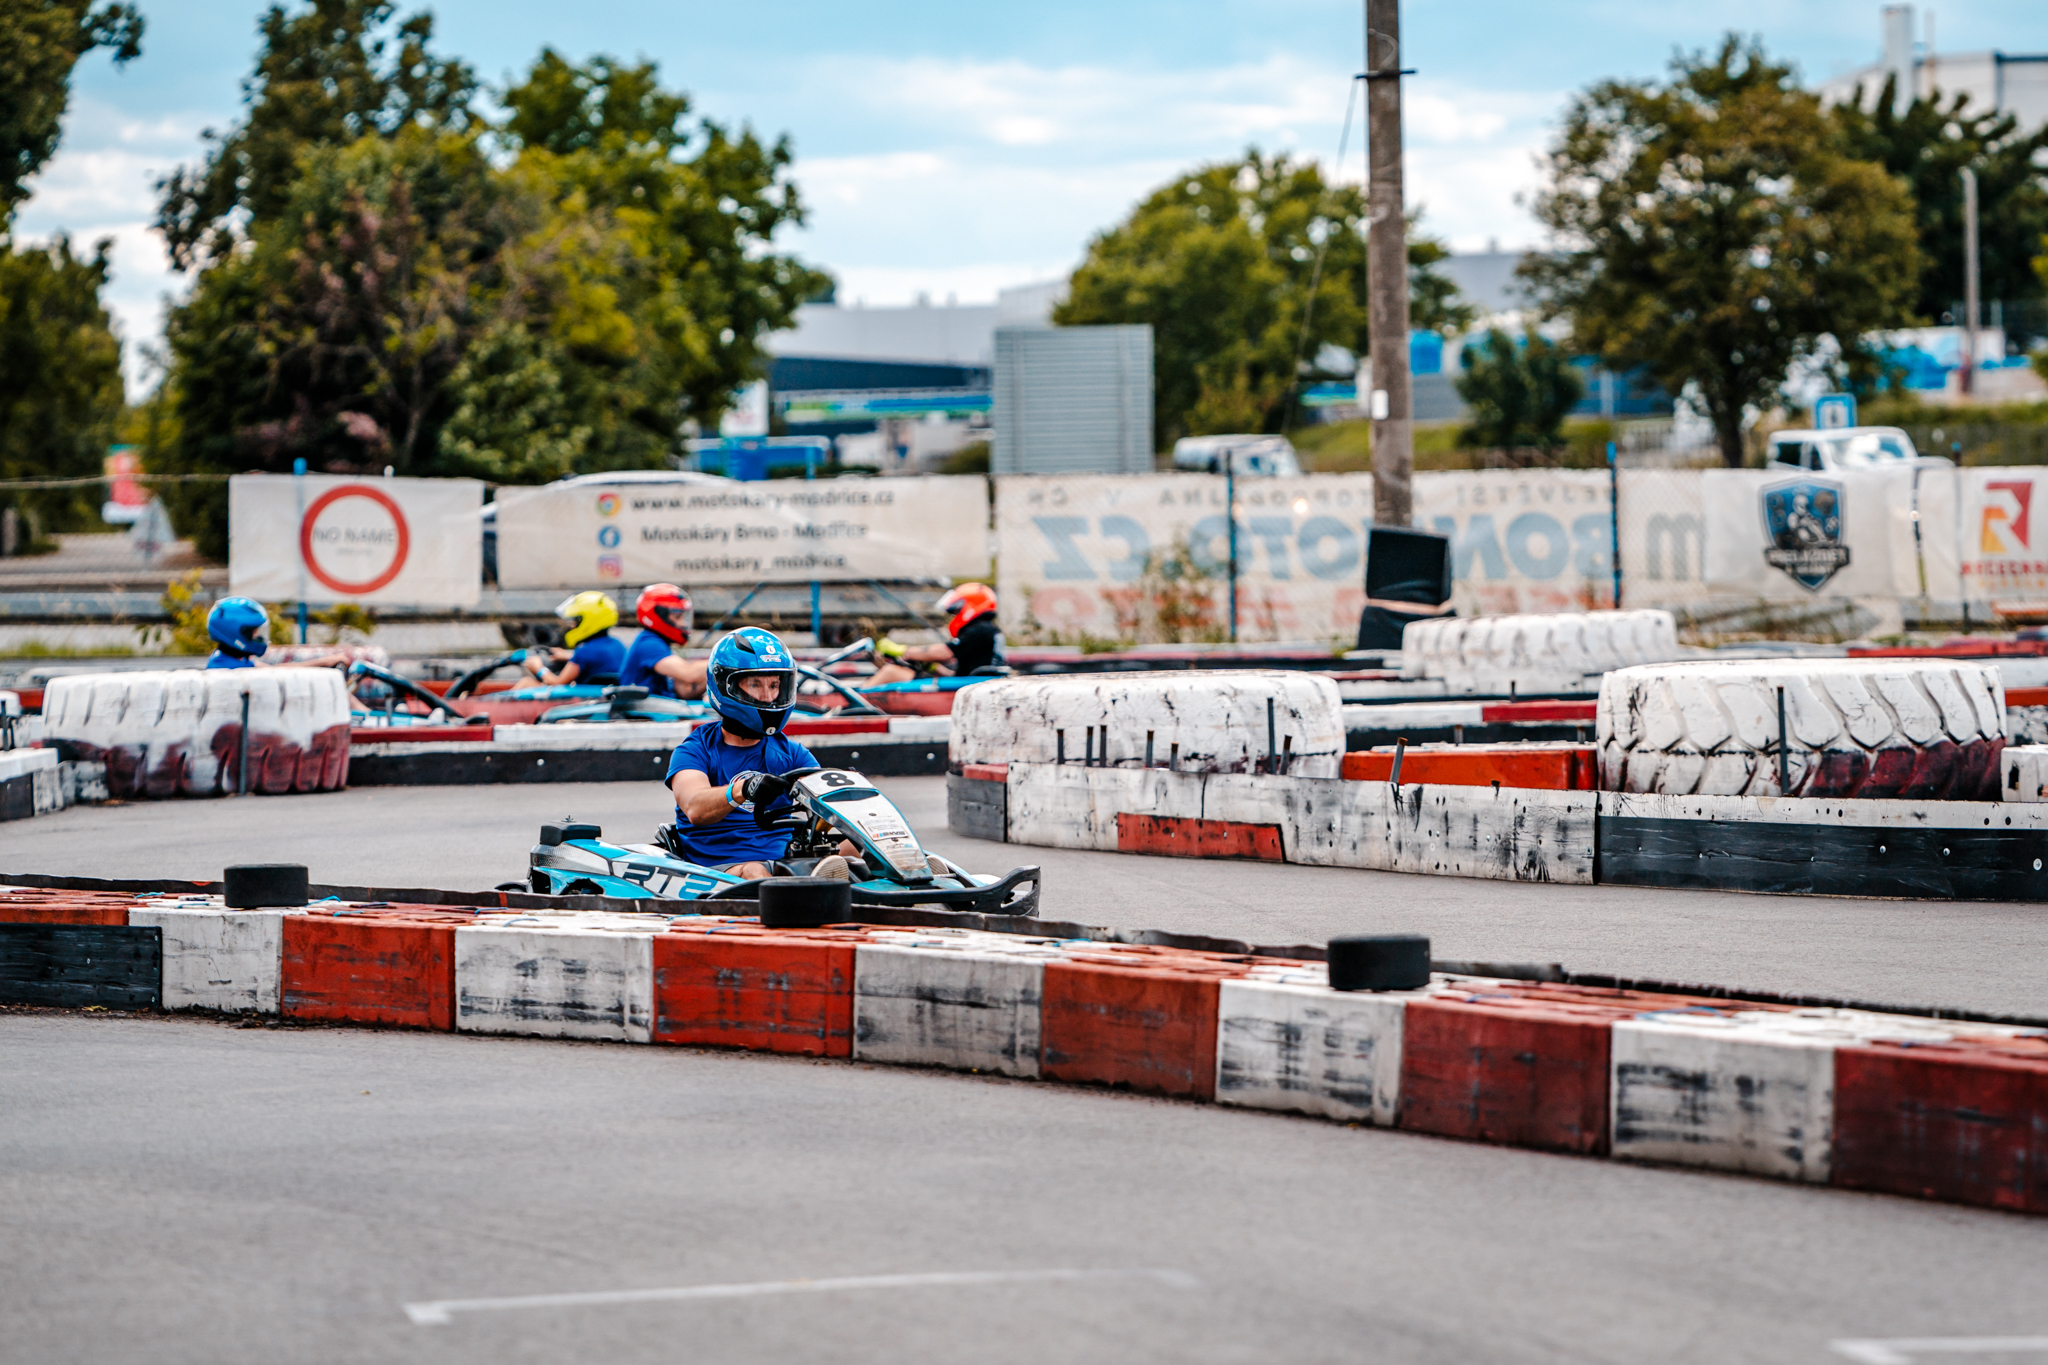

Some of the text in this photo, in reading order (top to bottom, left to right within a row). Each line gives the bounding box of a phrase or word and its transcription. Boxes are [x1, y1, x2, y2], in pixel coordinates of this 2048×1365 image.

[313, 526, 395, 545] NO NAME
[735, 524, 778, 541] Brno
[821, 772, 855, 787] 8
